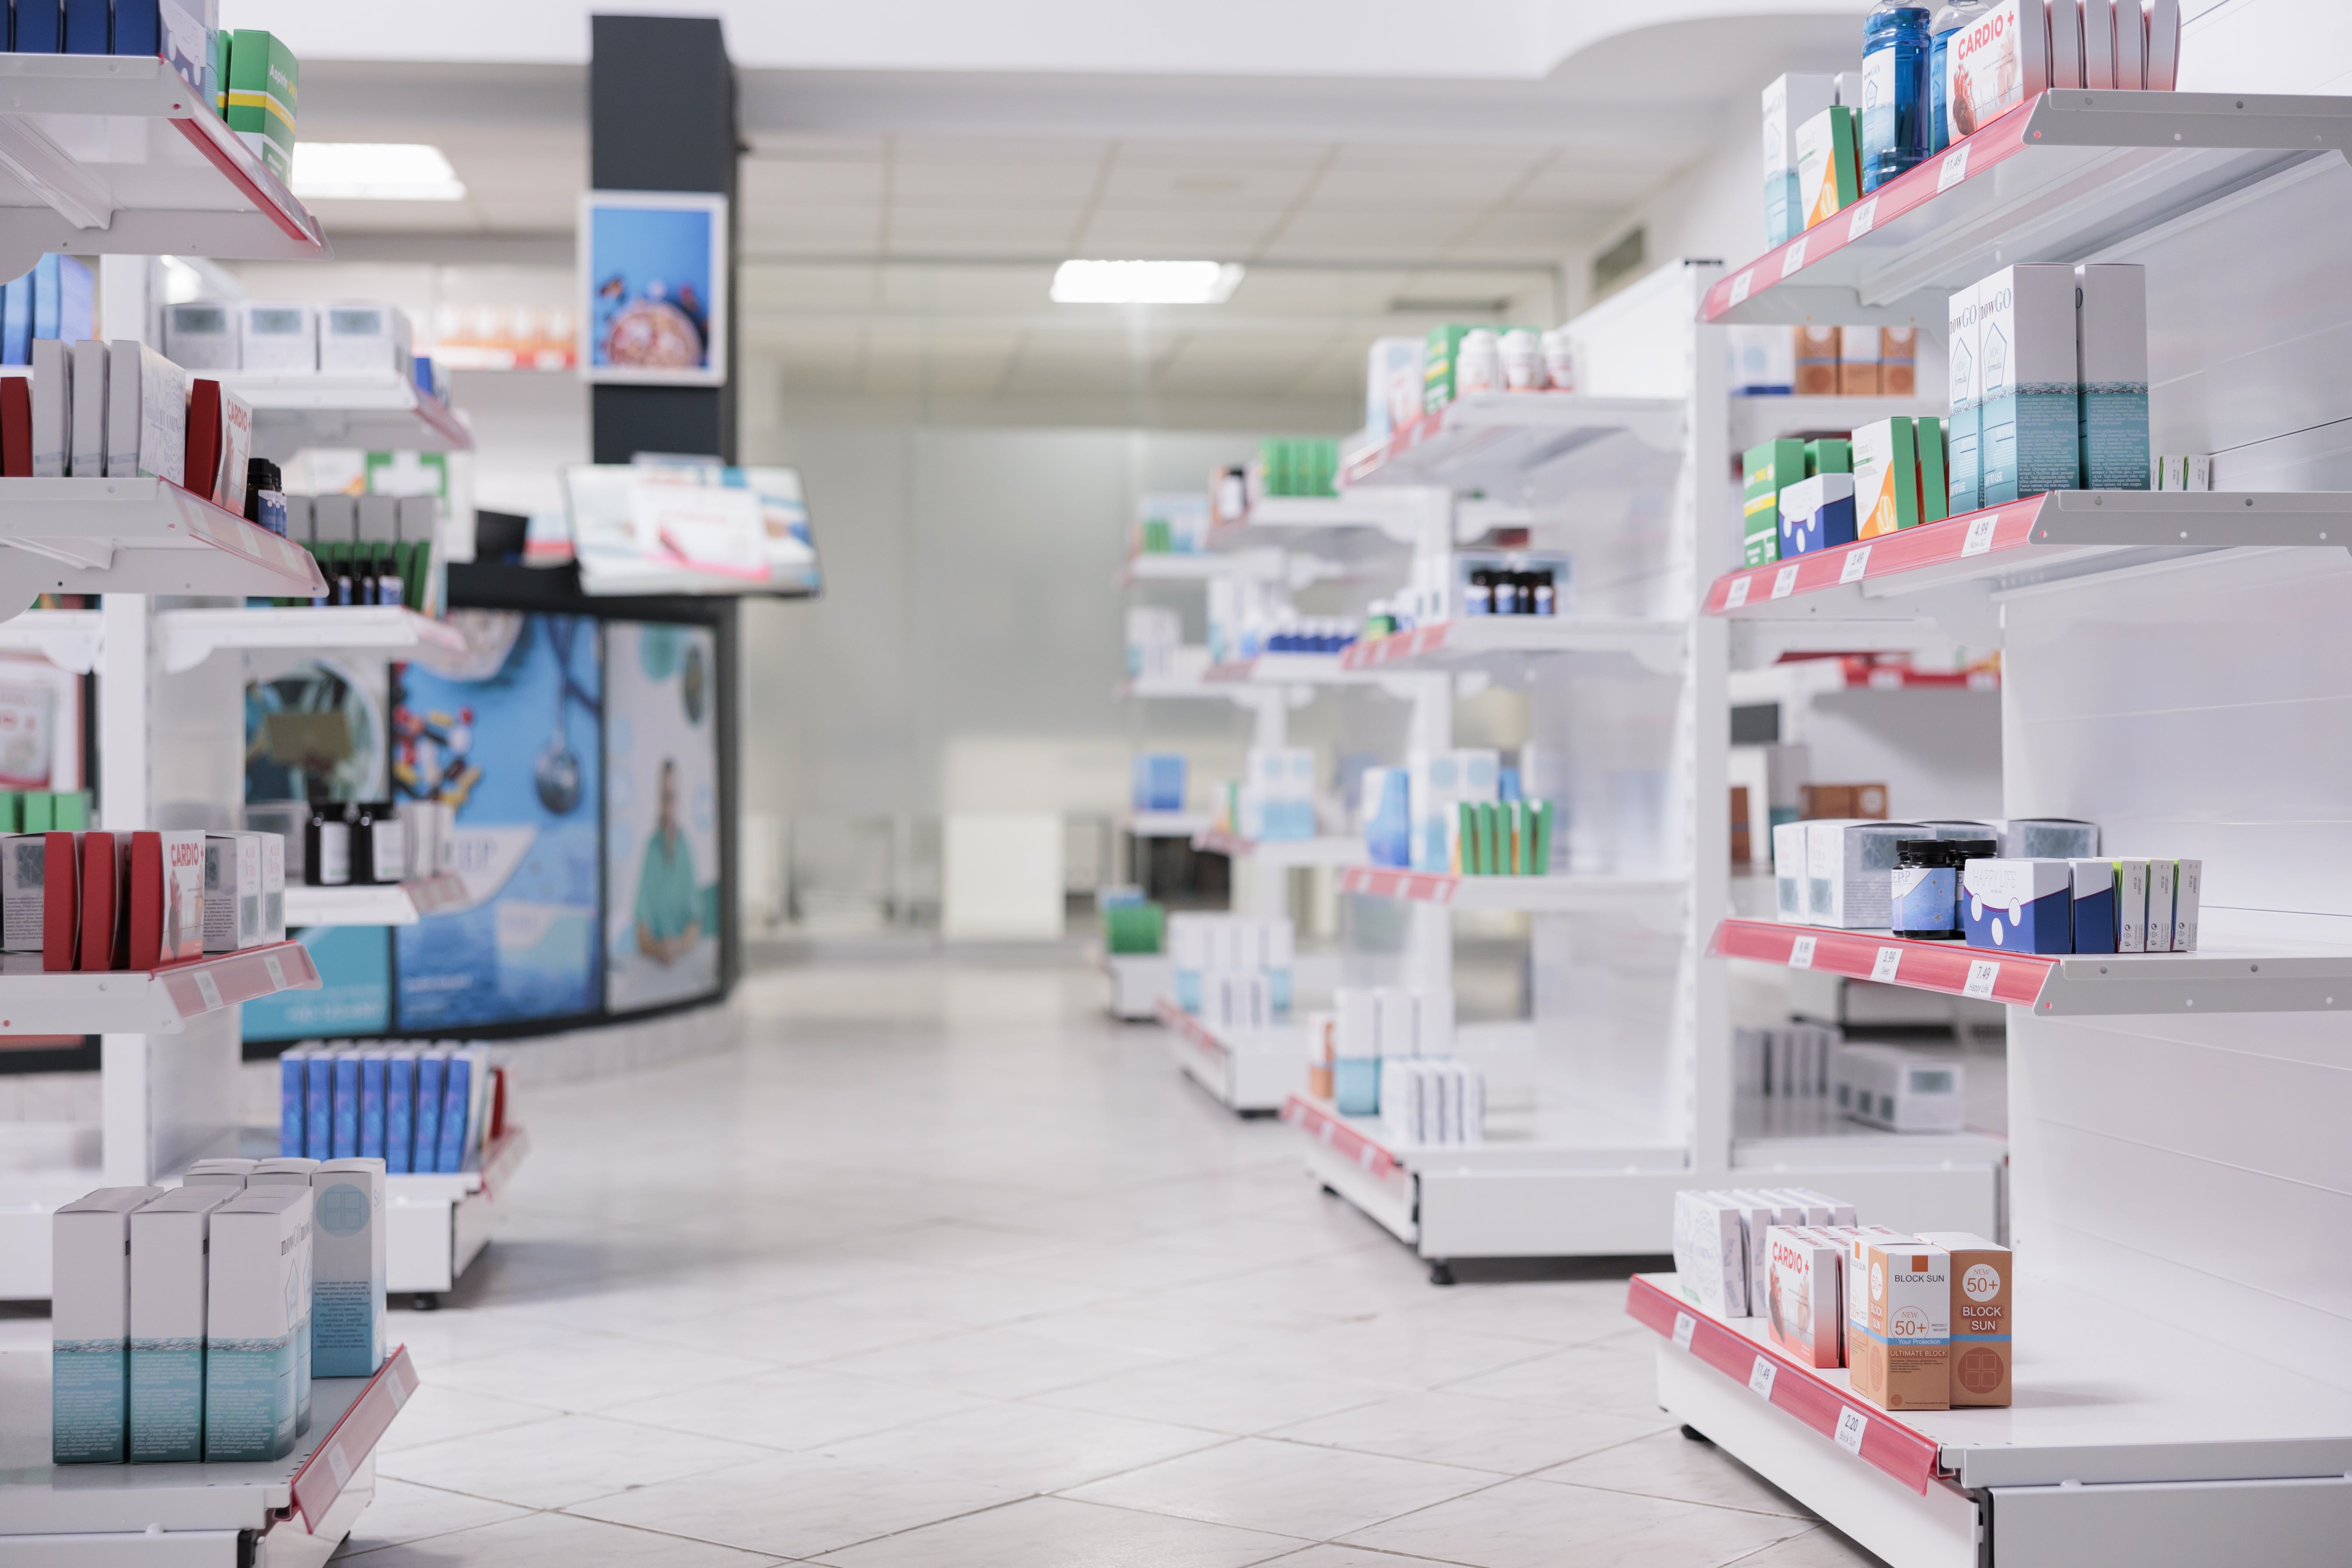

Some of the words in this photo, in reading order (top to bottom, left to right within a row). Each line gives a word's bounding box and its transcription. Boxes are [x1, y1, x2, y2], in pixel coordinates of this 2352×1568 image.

[1958, 14, 2003, 60] CARDIO
[2008, 11, 2014, 27] +
[270, 63, 287, 90] Aspirin
[1946, 154, 1962, 173] 11.49
[1980, 288, 2011, 321] nowGO
[1949, 305, 1977, 335] nowGO
[227, 399, 247, 432] CARDIO
[1974, 521, 1989, 537] 4.99
[171, 842, 199, 867] CARDIO
[1973, 869, 1998, 887] HAPPY
[2000, 870, 2016, 889] LIFE
[1883, 951, 1896, 963] 3.99
[1976, 966, 1991, 980] 7.49
[1968, 983, 1981, 994] Happy
[1773, 1241, 1802, 1274] CARDIO
[1851, 1258, 1859, 1268] BLOCK
[1872, 1275, 1882, 1291] 50+
[1967, 1278, 1998, 1292] 50+
[1871, 1302, 1883, 1318] BLOCK
[1963, 1307, 2001, 1316] BLOCK
[1895, 1321, 1926, 1335] 50+
[1971, 1321, 1995, 1330] SUN
[1757, 1363, 1770, 1380] 11.49
[1845, 1414, 1858, 1432] 2.20
[1840, 1431, 1849, 1442] Block
